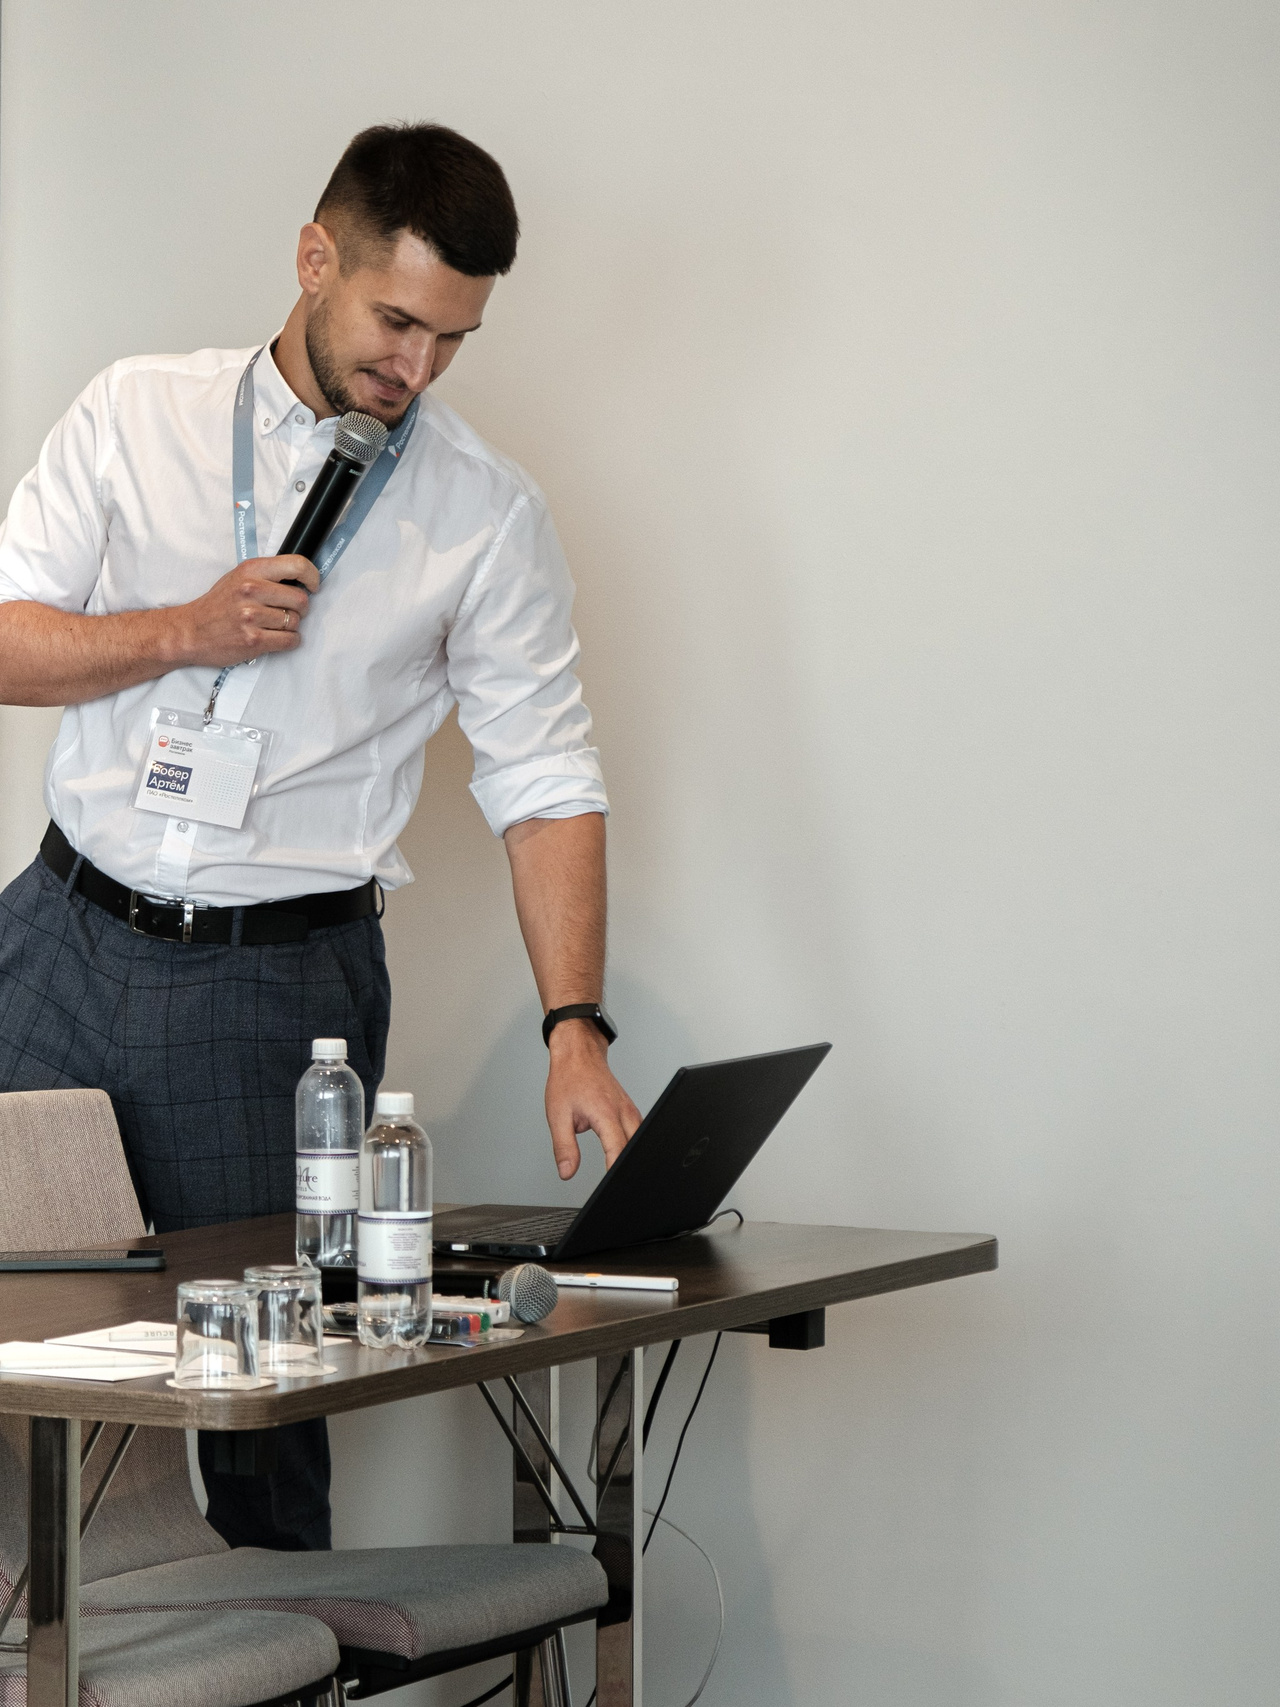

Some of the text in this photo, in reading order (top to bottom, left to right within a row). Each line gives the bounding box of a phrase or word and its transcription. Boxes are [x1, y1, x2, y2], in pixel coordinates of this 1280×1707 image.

[238, 510, 248, 560] Ростелеком
[319, 537, 346, 575] остелеком
[149, 776, 185, 792] Артём
